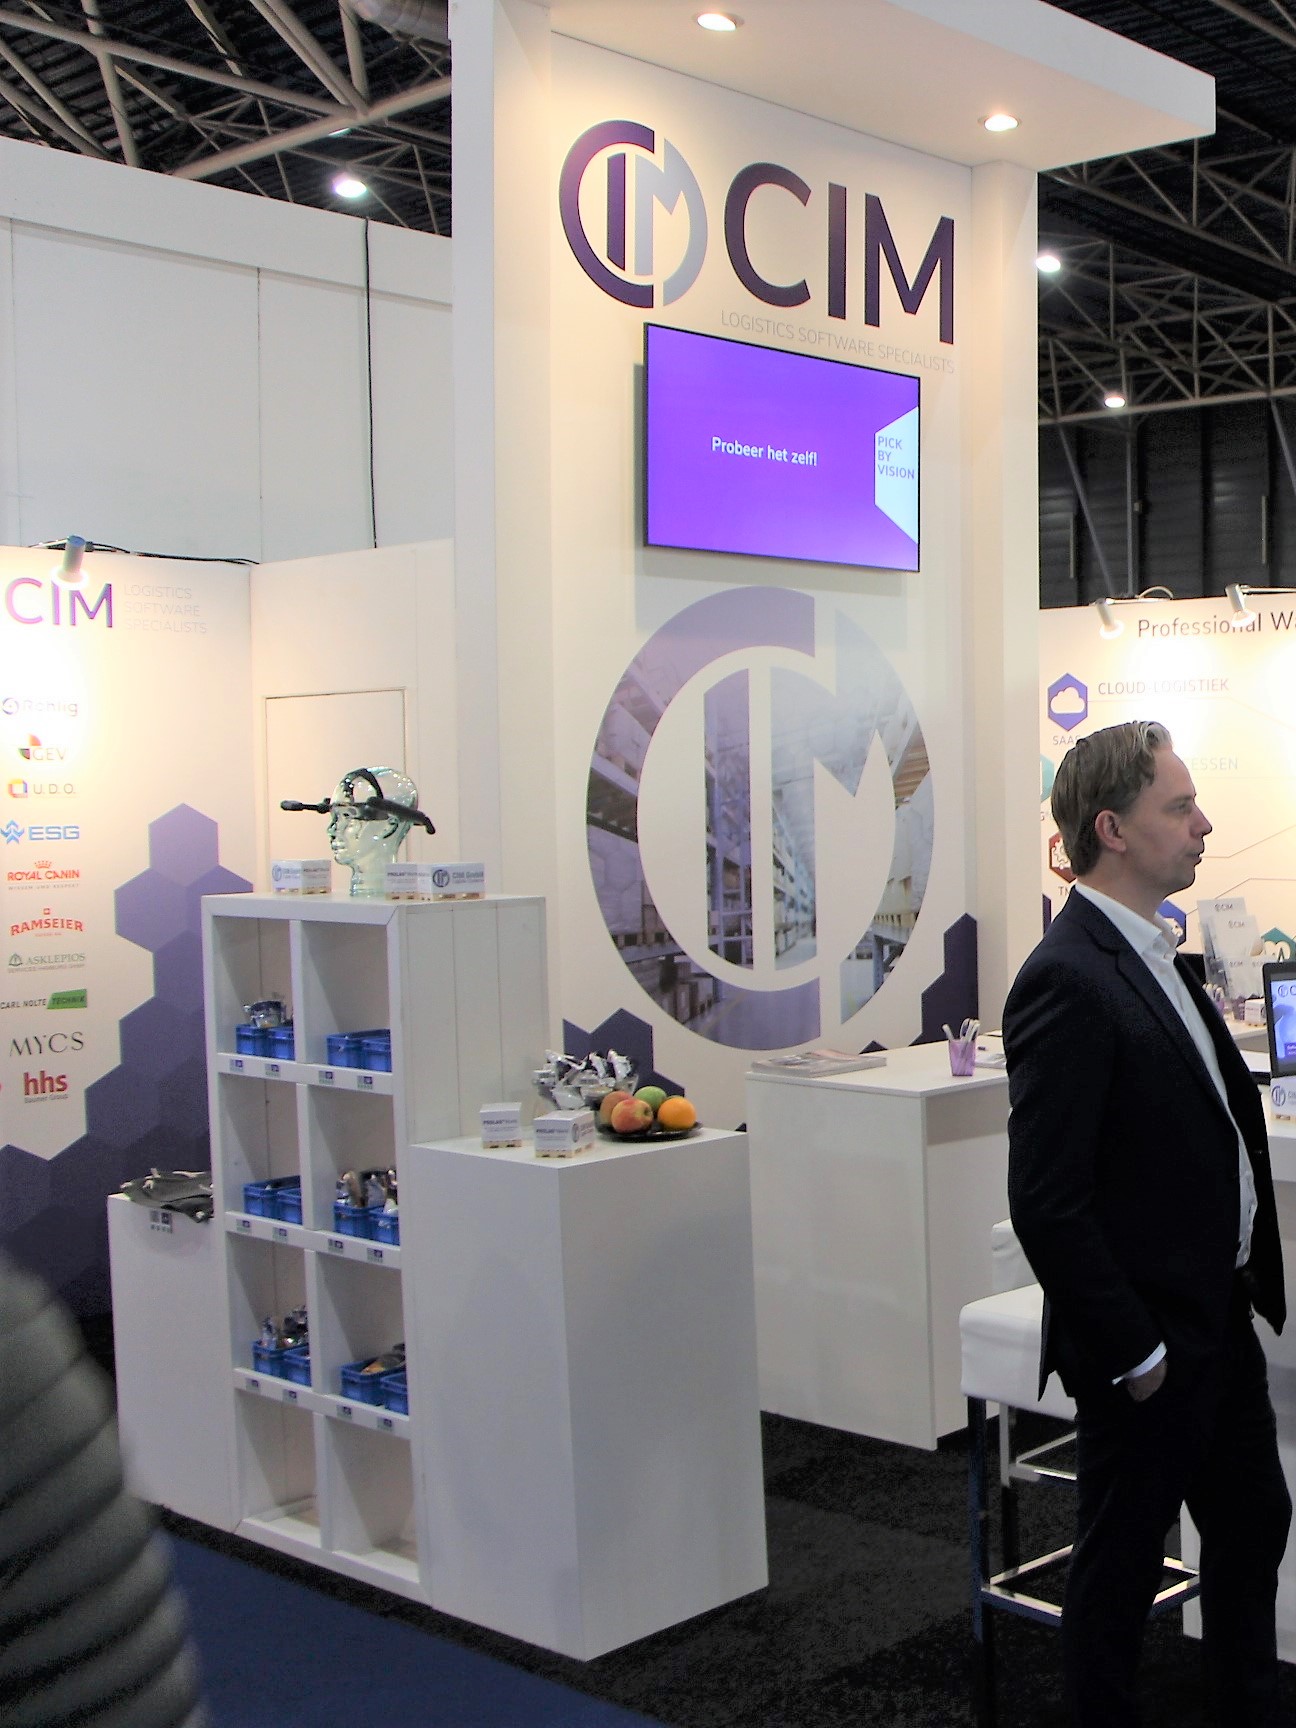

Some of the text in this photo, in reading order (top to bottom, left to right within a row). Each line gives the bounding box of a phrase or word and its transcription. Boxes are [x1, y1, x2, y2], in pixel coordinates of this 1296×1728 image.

[724, 162, 955, 345] CIM
[721, 310, 956, 375] LOGISTICS SOFTWARE SPECIALISTS
[877, 435, 903, 450] PICK
[711, 437, 818, 467] Probeer het zelf!
[877, 450, 892, 463] BY
[877, 464, 915, 480] VISION
[124, 584, 193, 600] LOGISTICS
[4, 576, 114, 629] CIM
[125, 602, 201, 618] SOFTWARE
[126, 619, 208, 635] SPECIALISTS
[1191, 757, 1239, 771] ESSEN
[28, 825, 80, 841] ESG
[7, 868, 81, 882] ROYAL CANIN
[10, 917, 85, 937] RAMSEIER
[27, 952, 86, 965] ASKLEPIOS
[9, 1030, 85, 1058] MYCS
[23, 1069, 70, 1097] hhs
